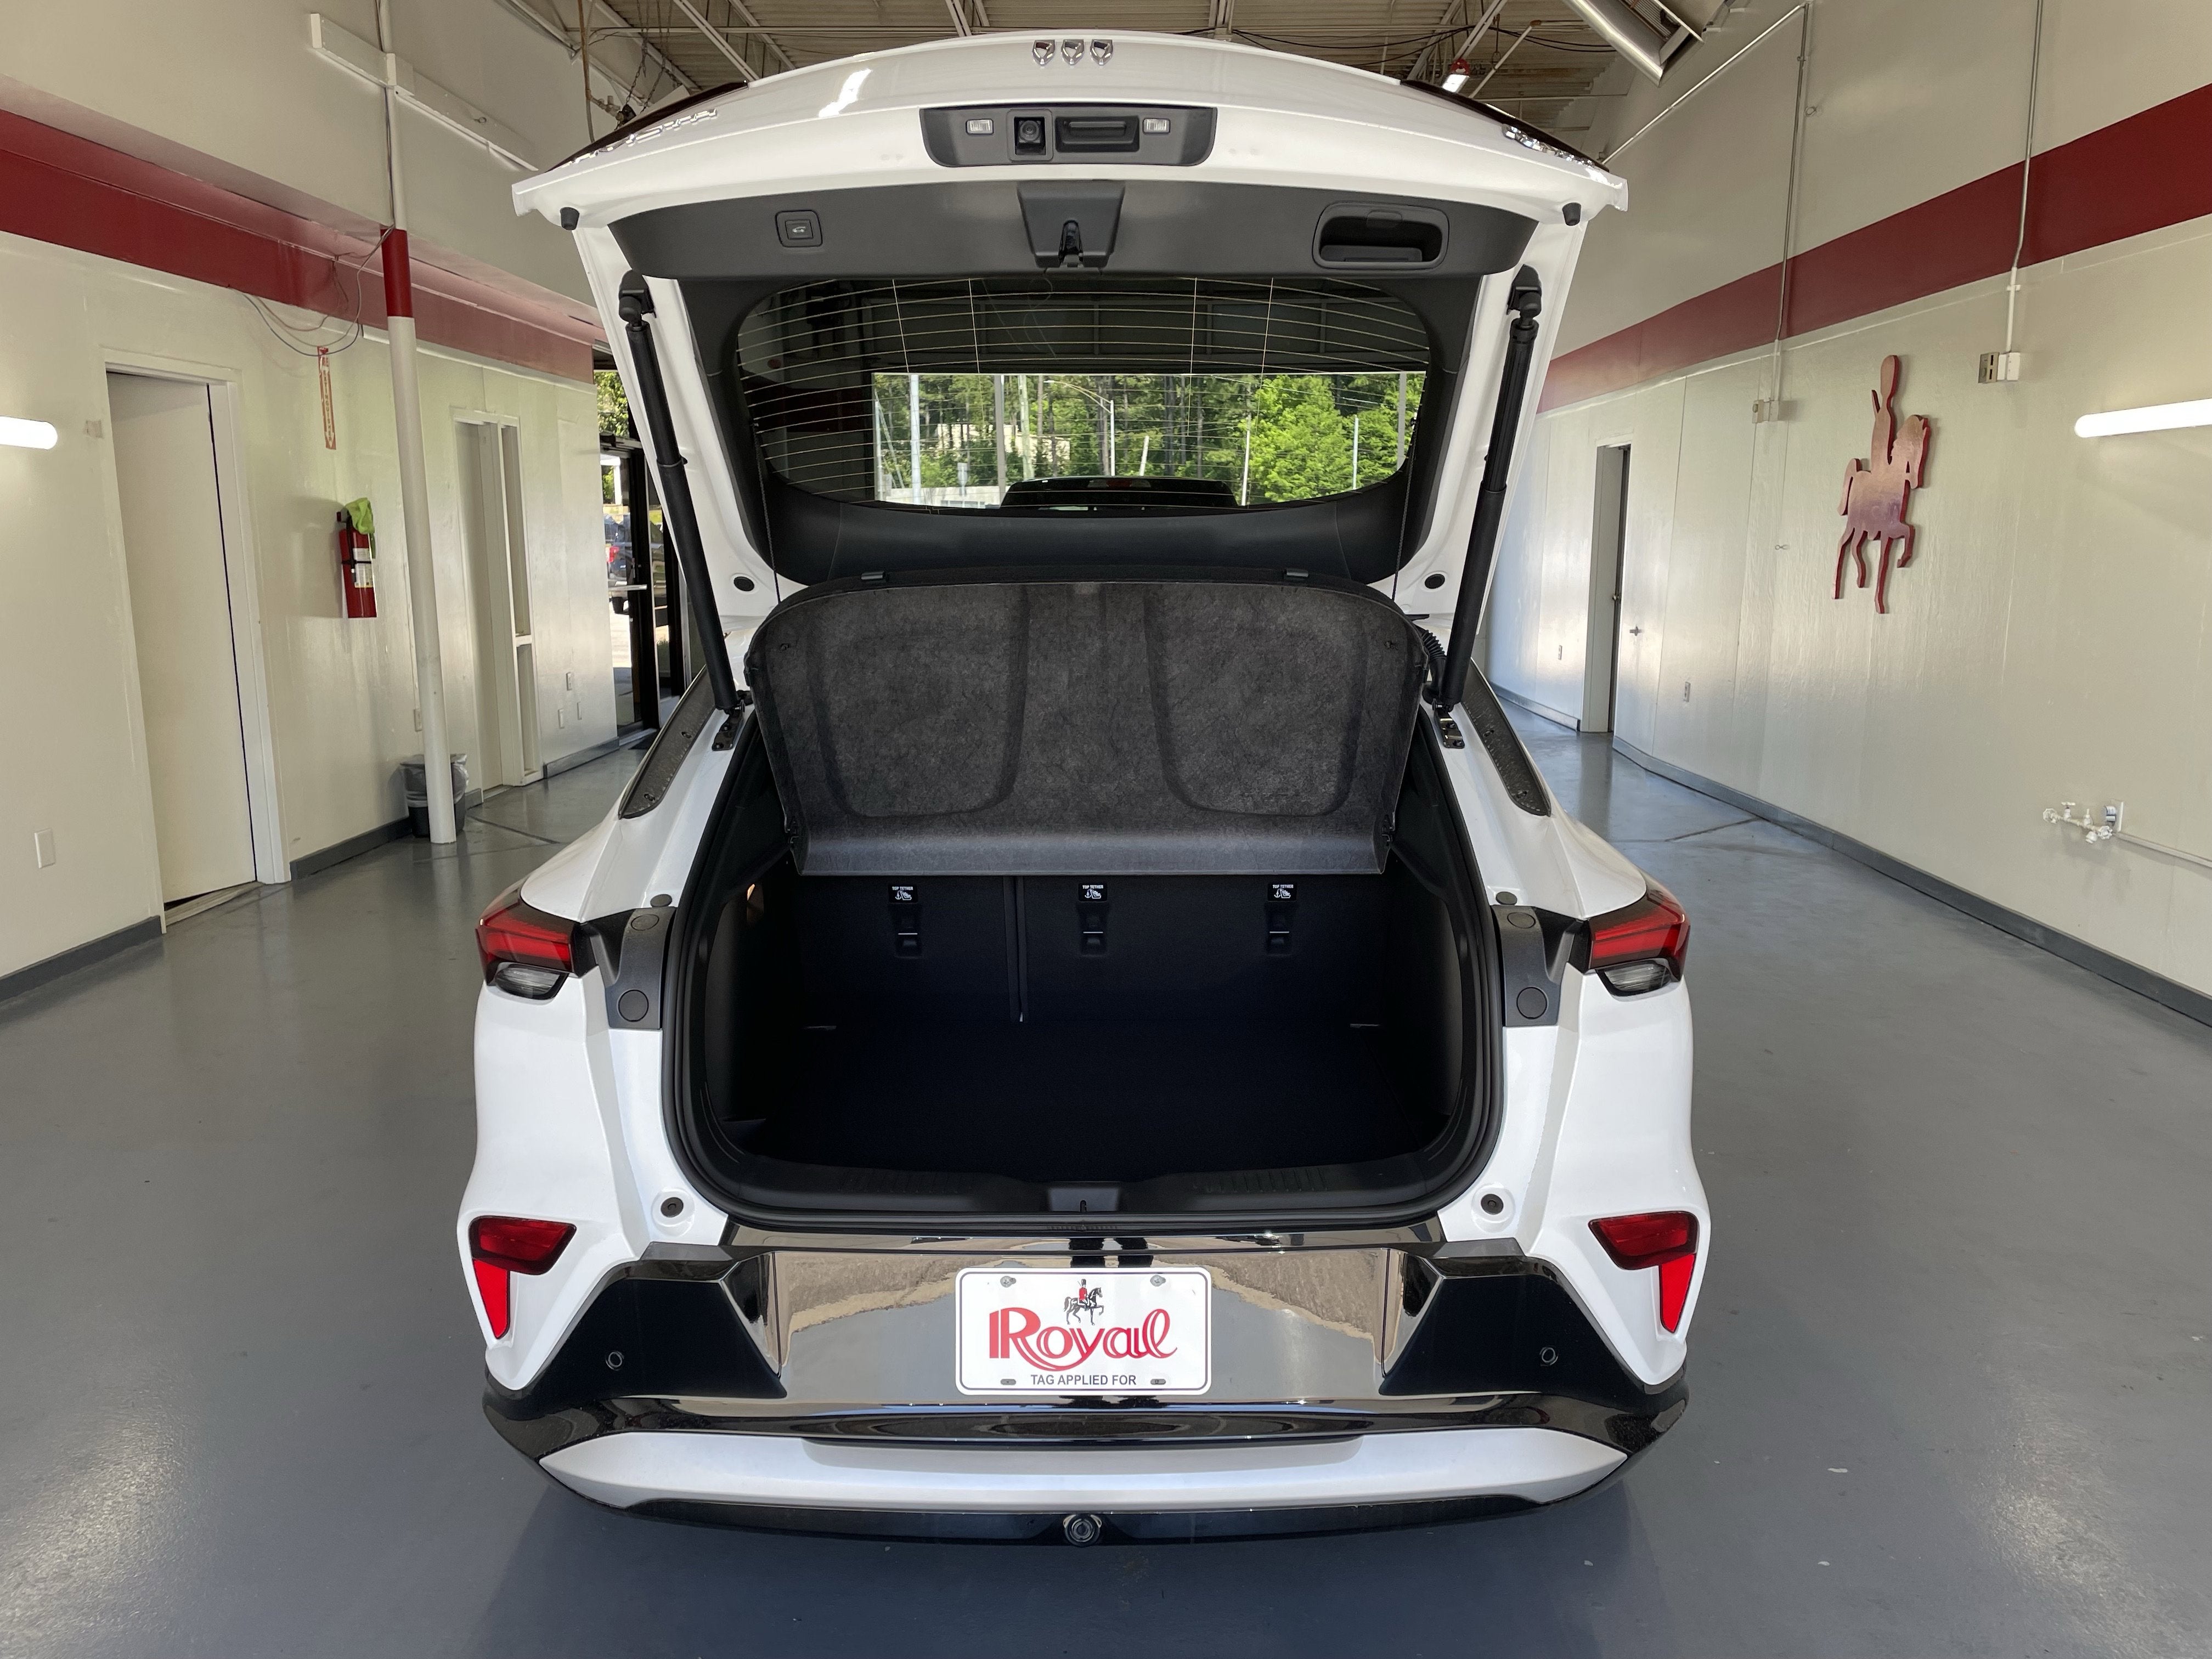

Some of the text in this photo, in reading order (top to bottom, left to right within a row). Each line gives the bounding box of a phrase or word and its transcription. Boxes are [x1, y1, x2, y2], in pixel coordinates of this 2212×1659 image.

[989, 1307, 1177, 1372] Royal
[1030, 1374, 1137, 1385] TAG APPLIED FOR
